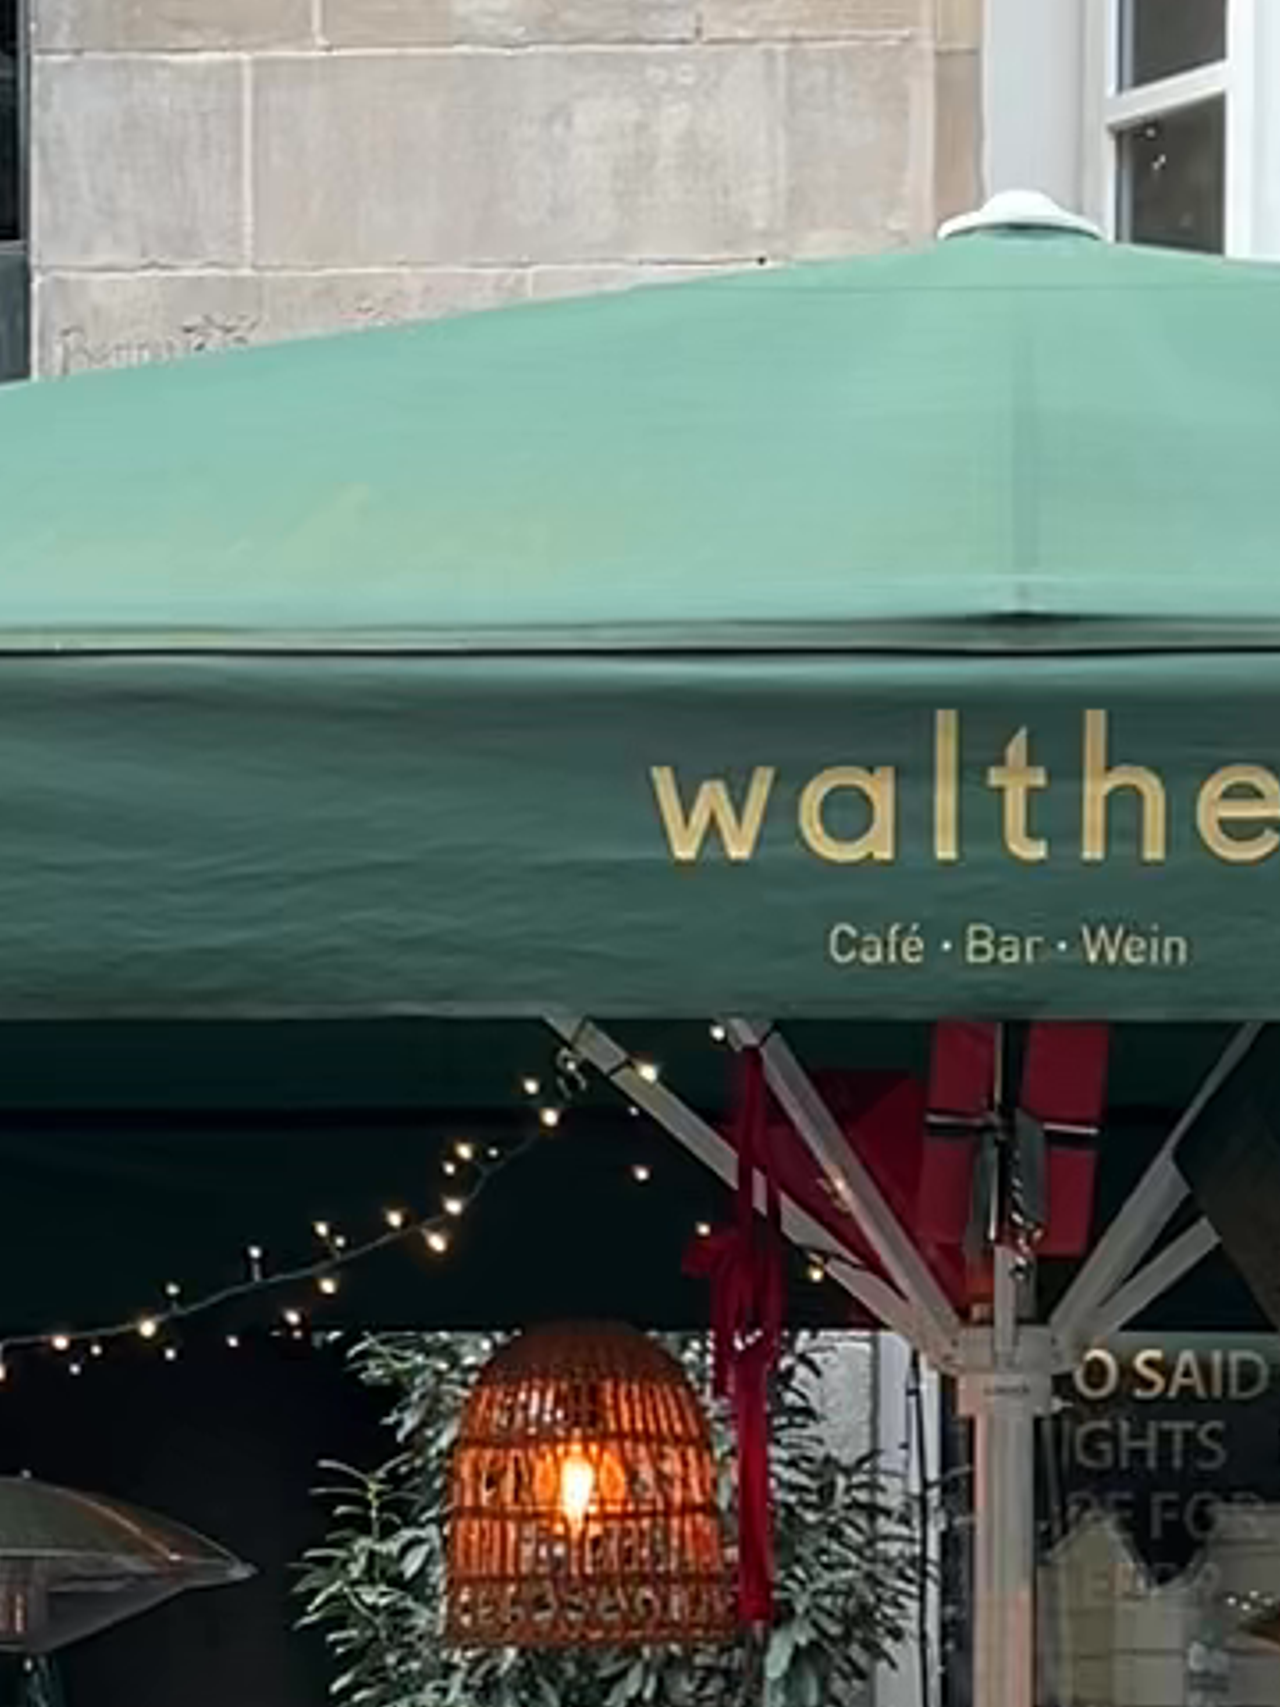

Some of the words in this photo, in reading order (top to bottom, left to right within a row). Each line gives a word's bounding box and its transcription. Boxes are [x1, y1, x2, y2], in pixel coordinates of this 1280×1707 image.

[828, 923, 925, 966] Café
[965, 925, 1044, 966] Bar
[1081, 924, 1189, 966] Wein
[1133, 1349, 1269, 1400] SAID
[1060, 1419, 1228, 1471] IGHTS
